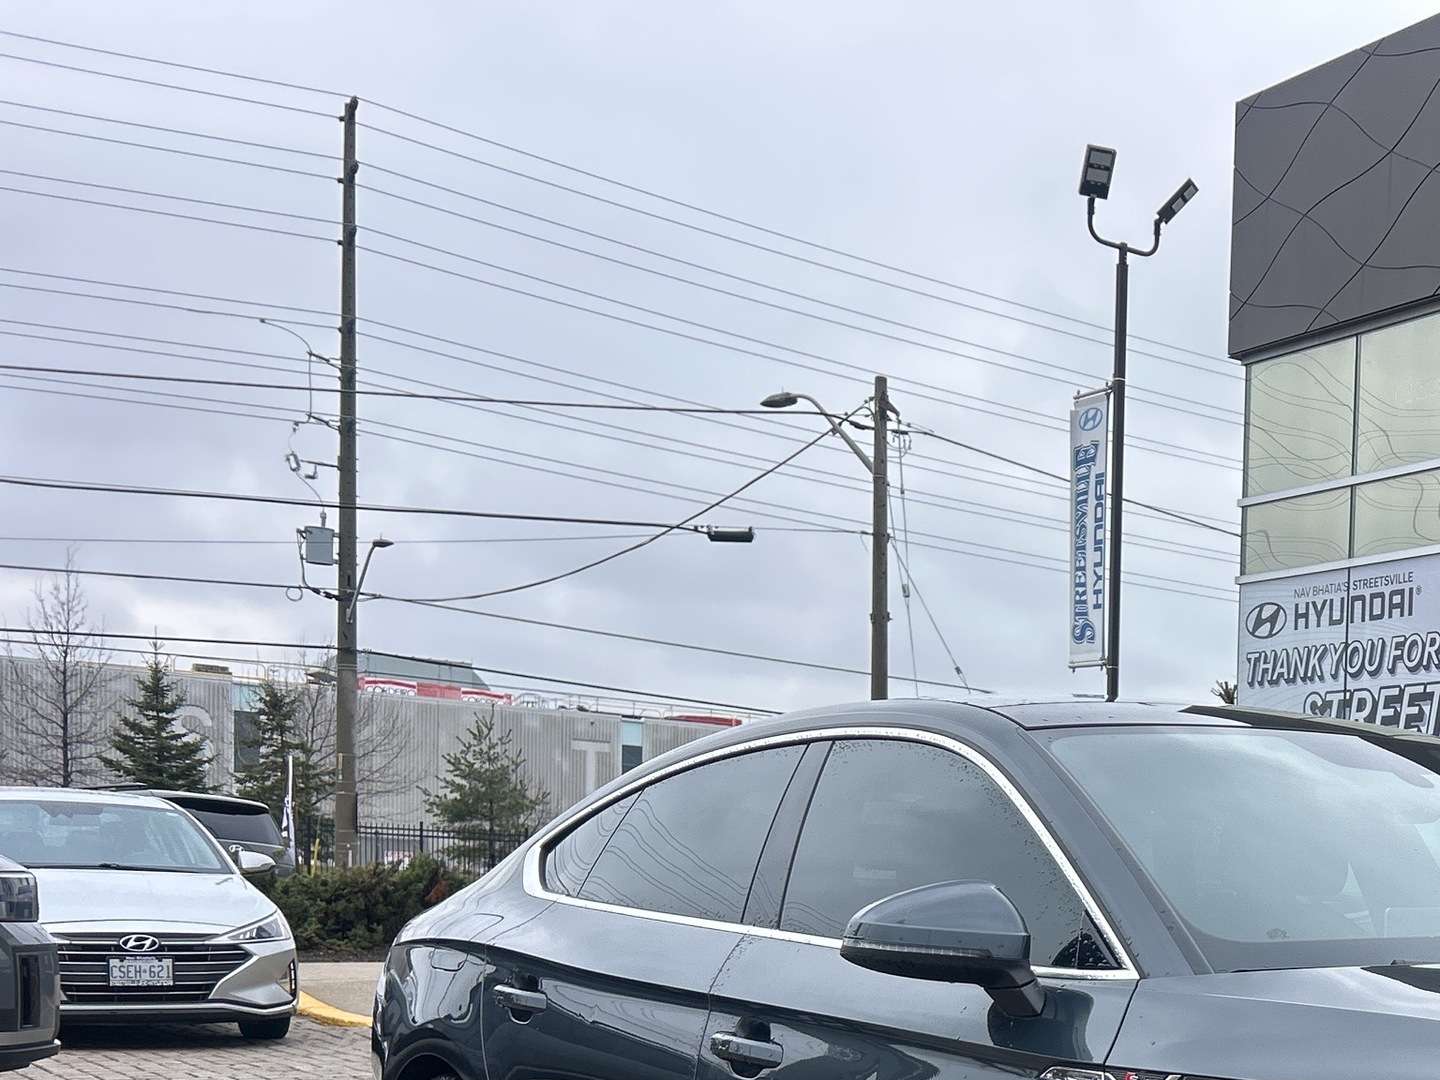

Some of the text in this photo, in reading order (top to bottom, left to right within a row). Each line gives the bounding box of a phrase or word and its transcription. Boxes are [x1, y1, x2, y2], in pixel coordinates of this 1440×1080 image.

[1092, 472, 1104, 609] HYUNDAI
[1294, 572, 1414, 598] NAV BHATIA'S STREETSVILLE
[1293, 586, 1415, 631] HYUNDAI
[1246, 643, 1327, 688] THANK
[1329, 637, 1386, 679] YOU
[110, 964, 172, 979] CSEH 621
